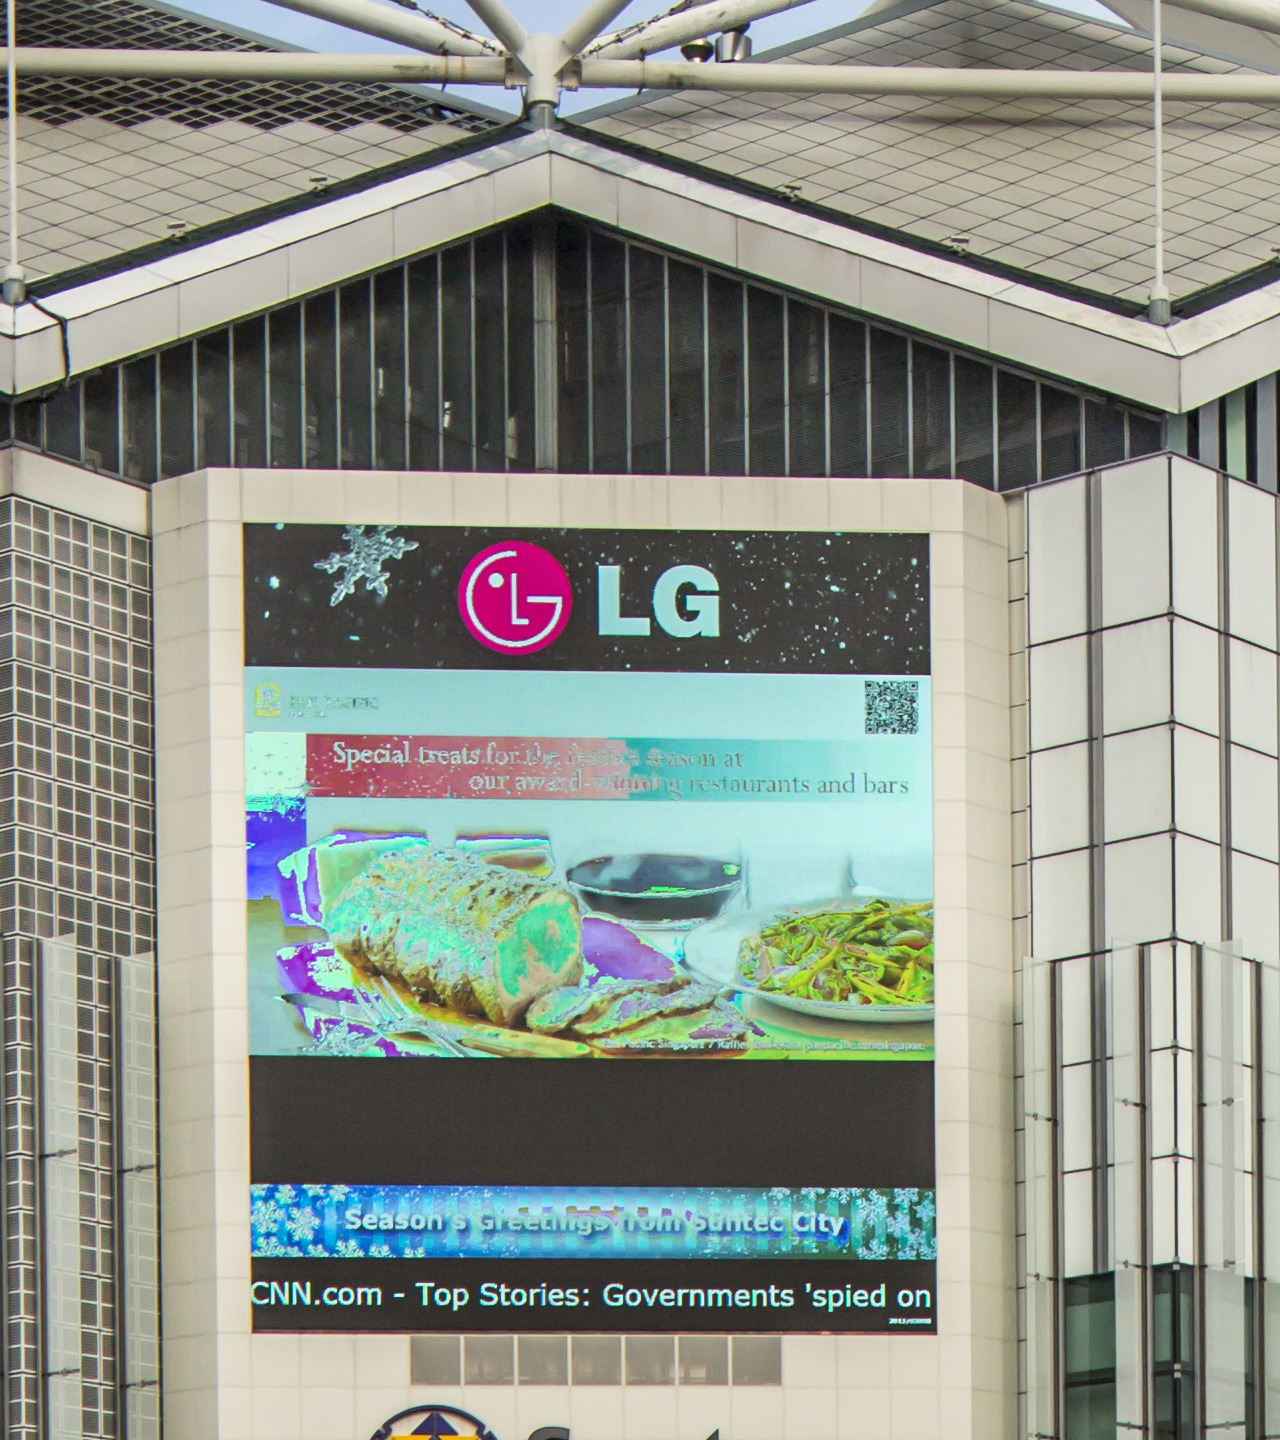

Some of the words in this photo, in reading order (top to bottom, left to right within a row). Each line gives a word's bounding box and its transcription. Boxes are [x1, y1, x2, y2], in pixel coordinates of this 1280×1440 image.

[598, 564, 720, 638] LG
[333, 741, 410, 771] Special
[419, 744, 480, 764] treats
[484, 741, 520, 764] for
[723, 750, 744, 769] at
[469, 774, 509, 791] our
[690, 774, 810, 794] restaurants
[817, 772, 856, 794] and
[863, 772, 909, 795] bars
[480, 1209, 610, 1236] Greetings
[691, 1210, 784, 1233] Suntec
[792, 1210, 845, 1238] City
[250, 1281, 382, 1306] CNN.com
[415, 1282, 469, 1311] Top
[479, 1282, 590, 1307] Stories:
[602, 1283, 795, 1308] Governments
[805, 1283, 886, 1312] 'spied
[896, 1291, 932, 1308] on
